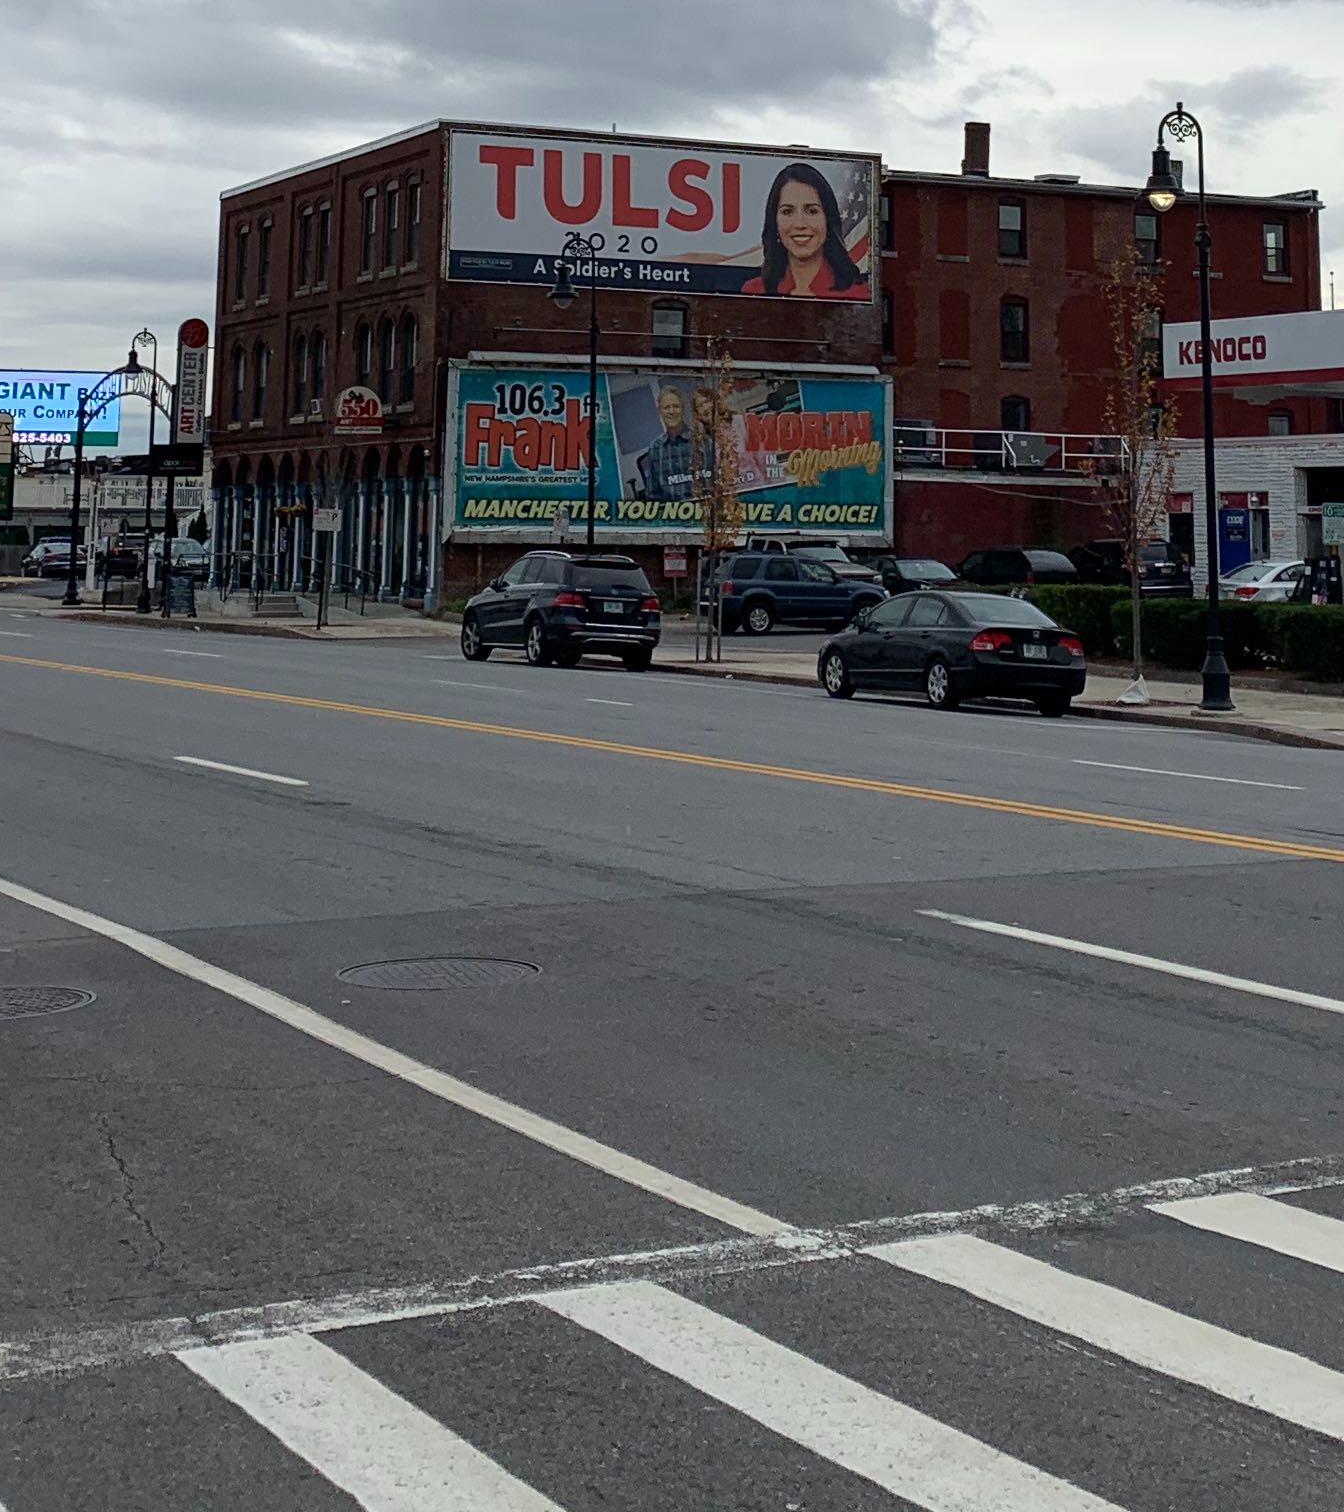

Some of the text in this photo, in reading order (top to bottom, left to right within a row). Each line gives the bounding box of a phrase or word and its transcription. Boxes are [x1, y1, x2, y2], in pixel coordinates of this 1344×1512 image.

[479, 144, 741, 234] TULSI
[533, 258, 547, 274] A
[553, 259, 633, 278] Soldier's
[639, 265, 691, 282] Heart
[1179, 335, 1267, 366] KENOCO
[182, 352, 196, 405] CENTER
[342, 398, 378, 416] 550
[494, 384, 565, 416] 106.3
[180, 407, 194, 434] ART
[744, 411, 873, 453] MORIN
[464, 398, 599, 472] Frank
[765, 454, 777, 465] IN
[766, 466, 785, 479] THE
[464, 474, 482, 483] NEW
[485, 474, 536, 484] HAMPSHIRE'S
[539, 475, 577, 484] GREATEST
[668, 473, 693, 485] Mike
[464, 499, 611, 520] MANCHESTER,
[617, 501, 653, 519] YOU
[776, 504, 792, 522] A
[798, 504, 879, 524] CHOICE!
